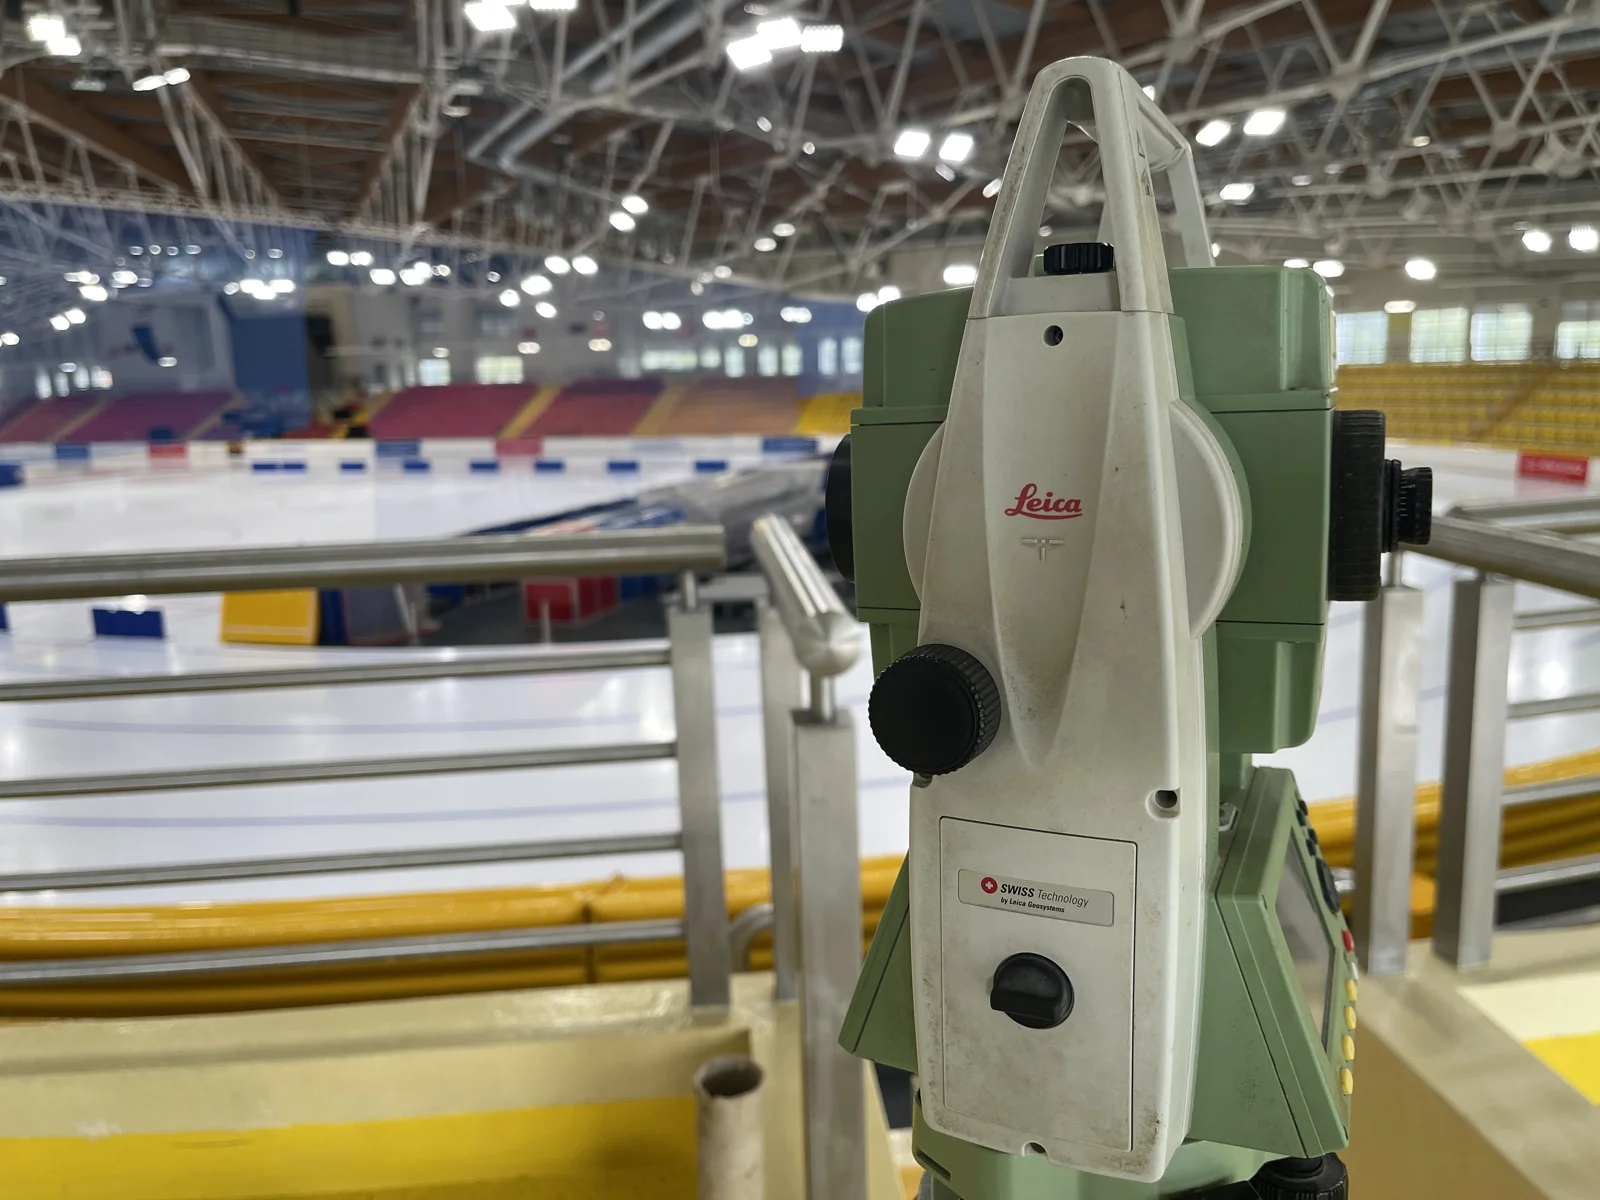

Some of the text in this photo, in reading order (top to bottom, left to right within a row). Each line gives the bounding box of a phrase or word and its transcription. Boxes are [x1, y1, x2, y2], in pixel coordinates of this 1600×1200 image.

[1004, 483, 1082, 520] Leica
[1000, 883, 1089, 908] SWISS Technology
[1000, 897, 1065, 913] by Leica Geosystems
